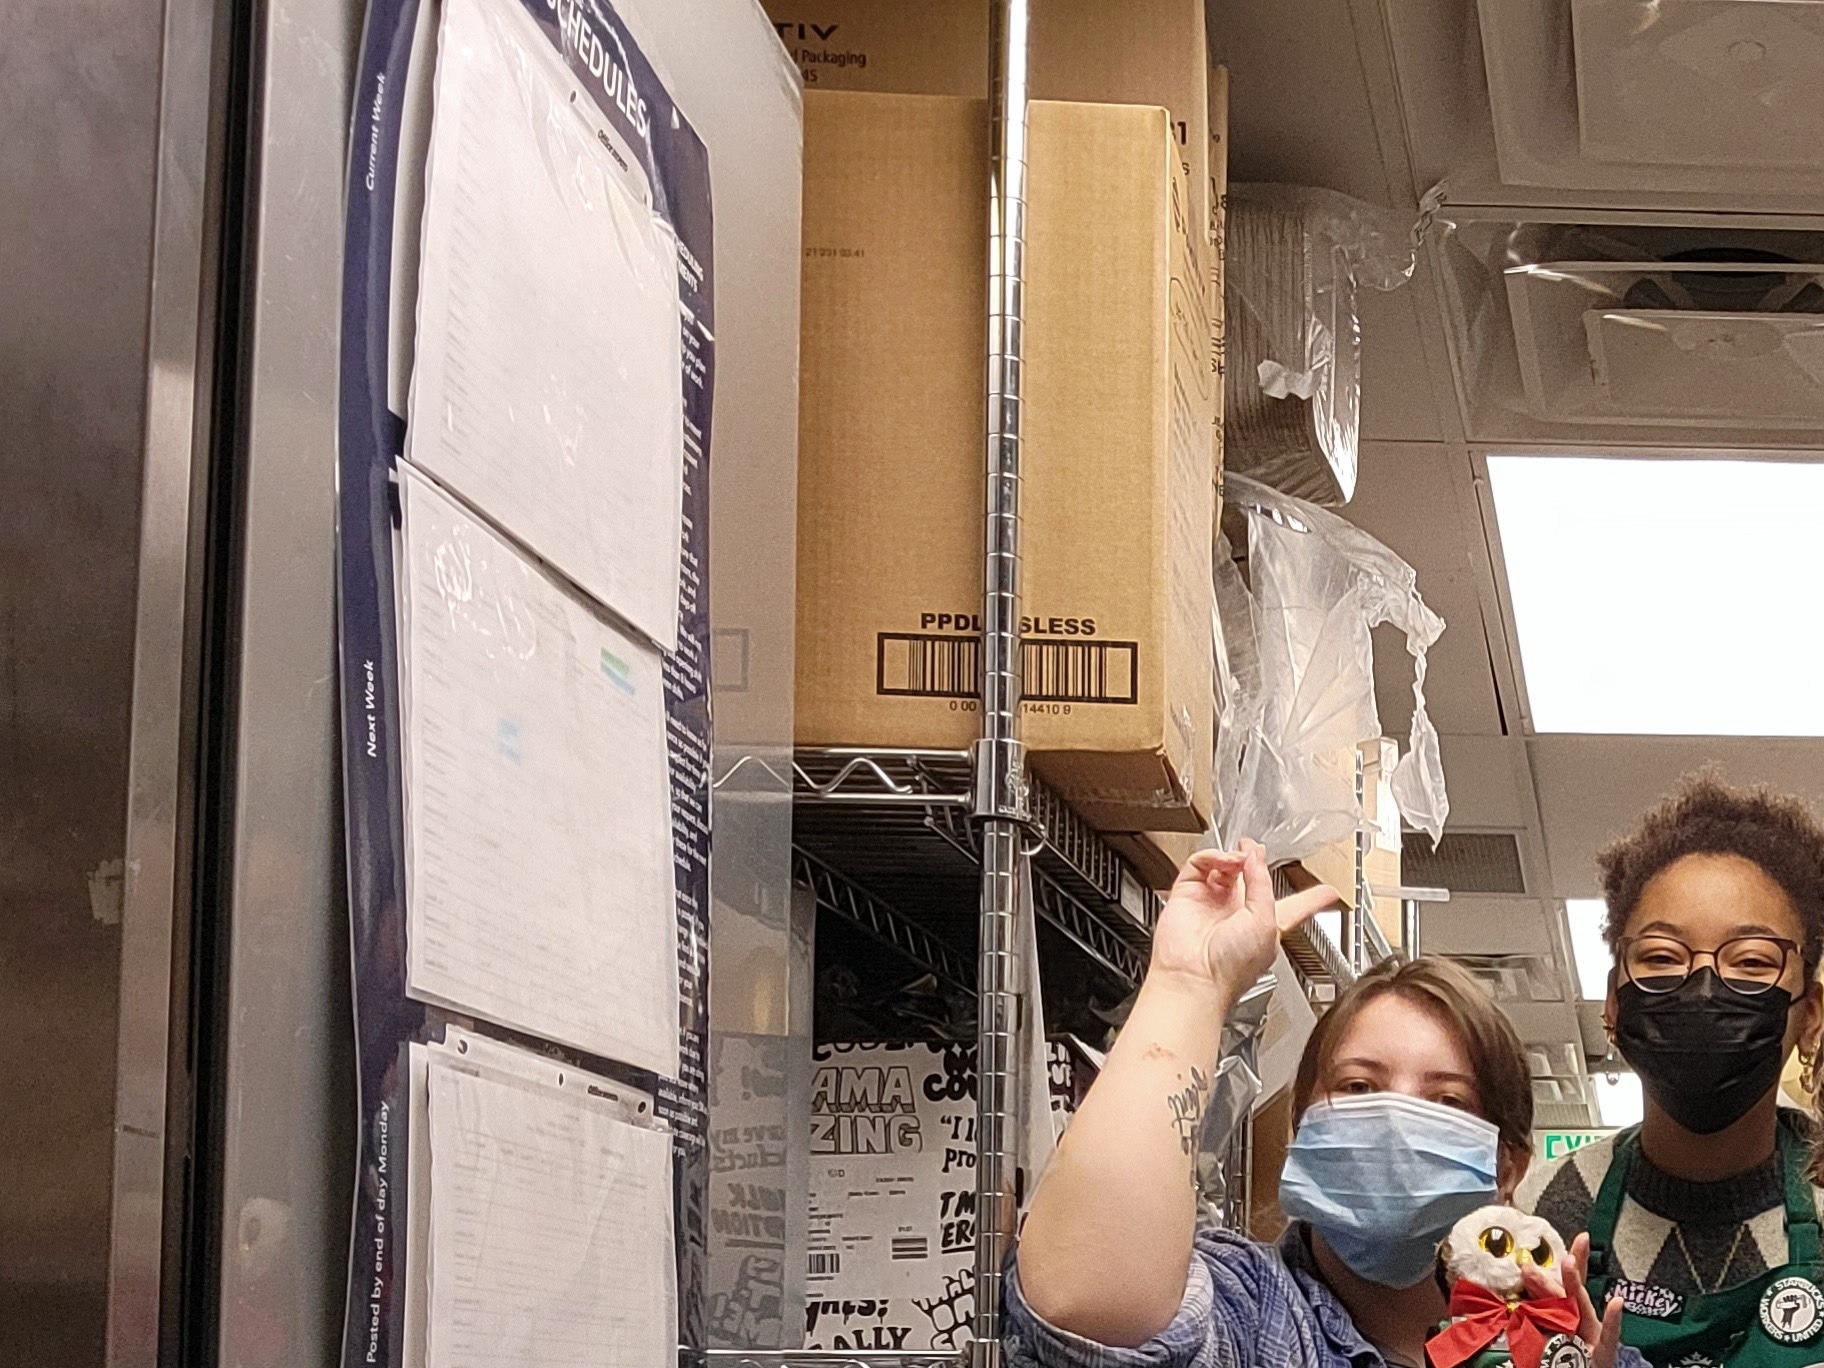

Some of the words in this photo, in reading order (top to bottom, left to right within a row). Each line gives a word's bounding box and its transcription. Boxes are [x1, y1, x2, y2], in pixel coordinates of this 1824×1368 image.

[548, 0, 647, 137] CHEDULES
[802, 49, 867, 68] Packaging
[371, 72, 386, 113] Week
[365, 118, 381, 191] Current
[364, 659, 377, 712] Week
[365, 716, 380, 757] Next
[378, 1101, 391, 1172] Monday
[376, 1175, 389, 1207] day
[374, 1211, 385, 1233] of
[374, 1240, 384, 1272] end
[371, 1277, 383, 1301] by
[1614, 1283, 1678, 1317] Mickey
[366, 1304, 380, 1363] Posted
